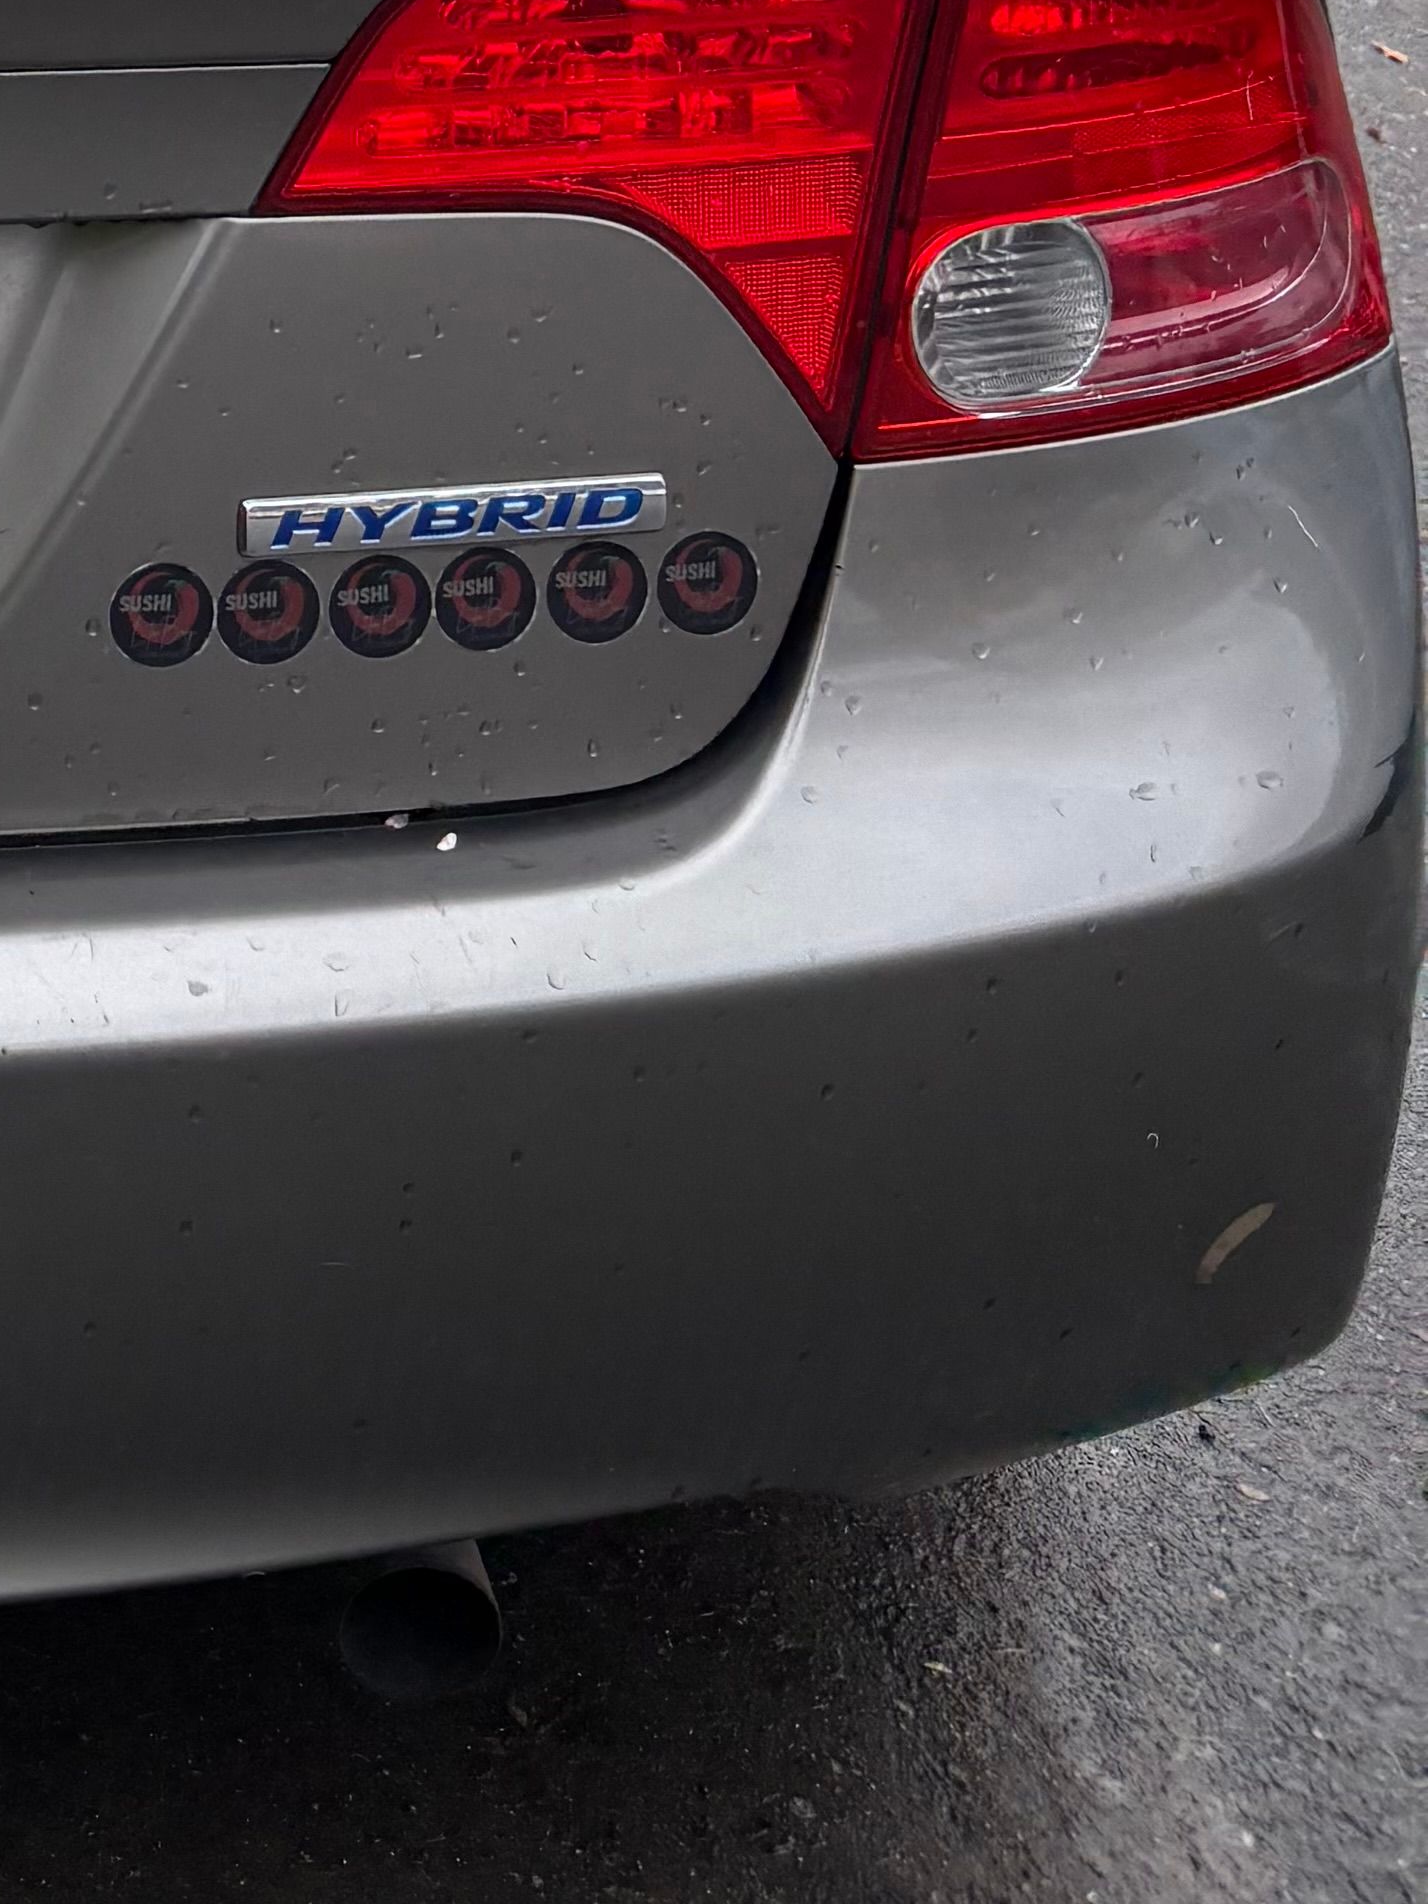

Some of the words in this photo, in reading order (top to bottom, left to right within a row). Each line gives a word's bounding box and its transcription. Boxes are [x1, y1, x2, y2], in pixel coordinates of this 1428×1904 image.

[270, 488, 645, 550] HYBRID
[555, 569, 607, 590] SUSHI
[665, 561, 716, 583] SUSHI
[337, 584, 389, 606] SUSHI
[442, 576, 494, 598] SUSHI
[119, 594, 173, 613] SUSHI
[225, 590, 278, 611] SUSHI
